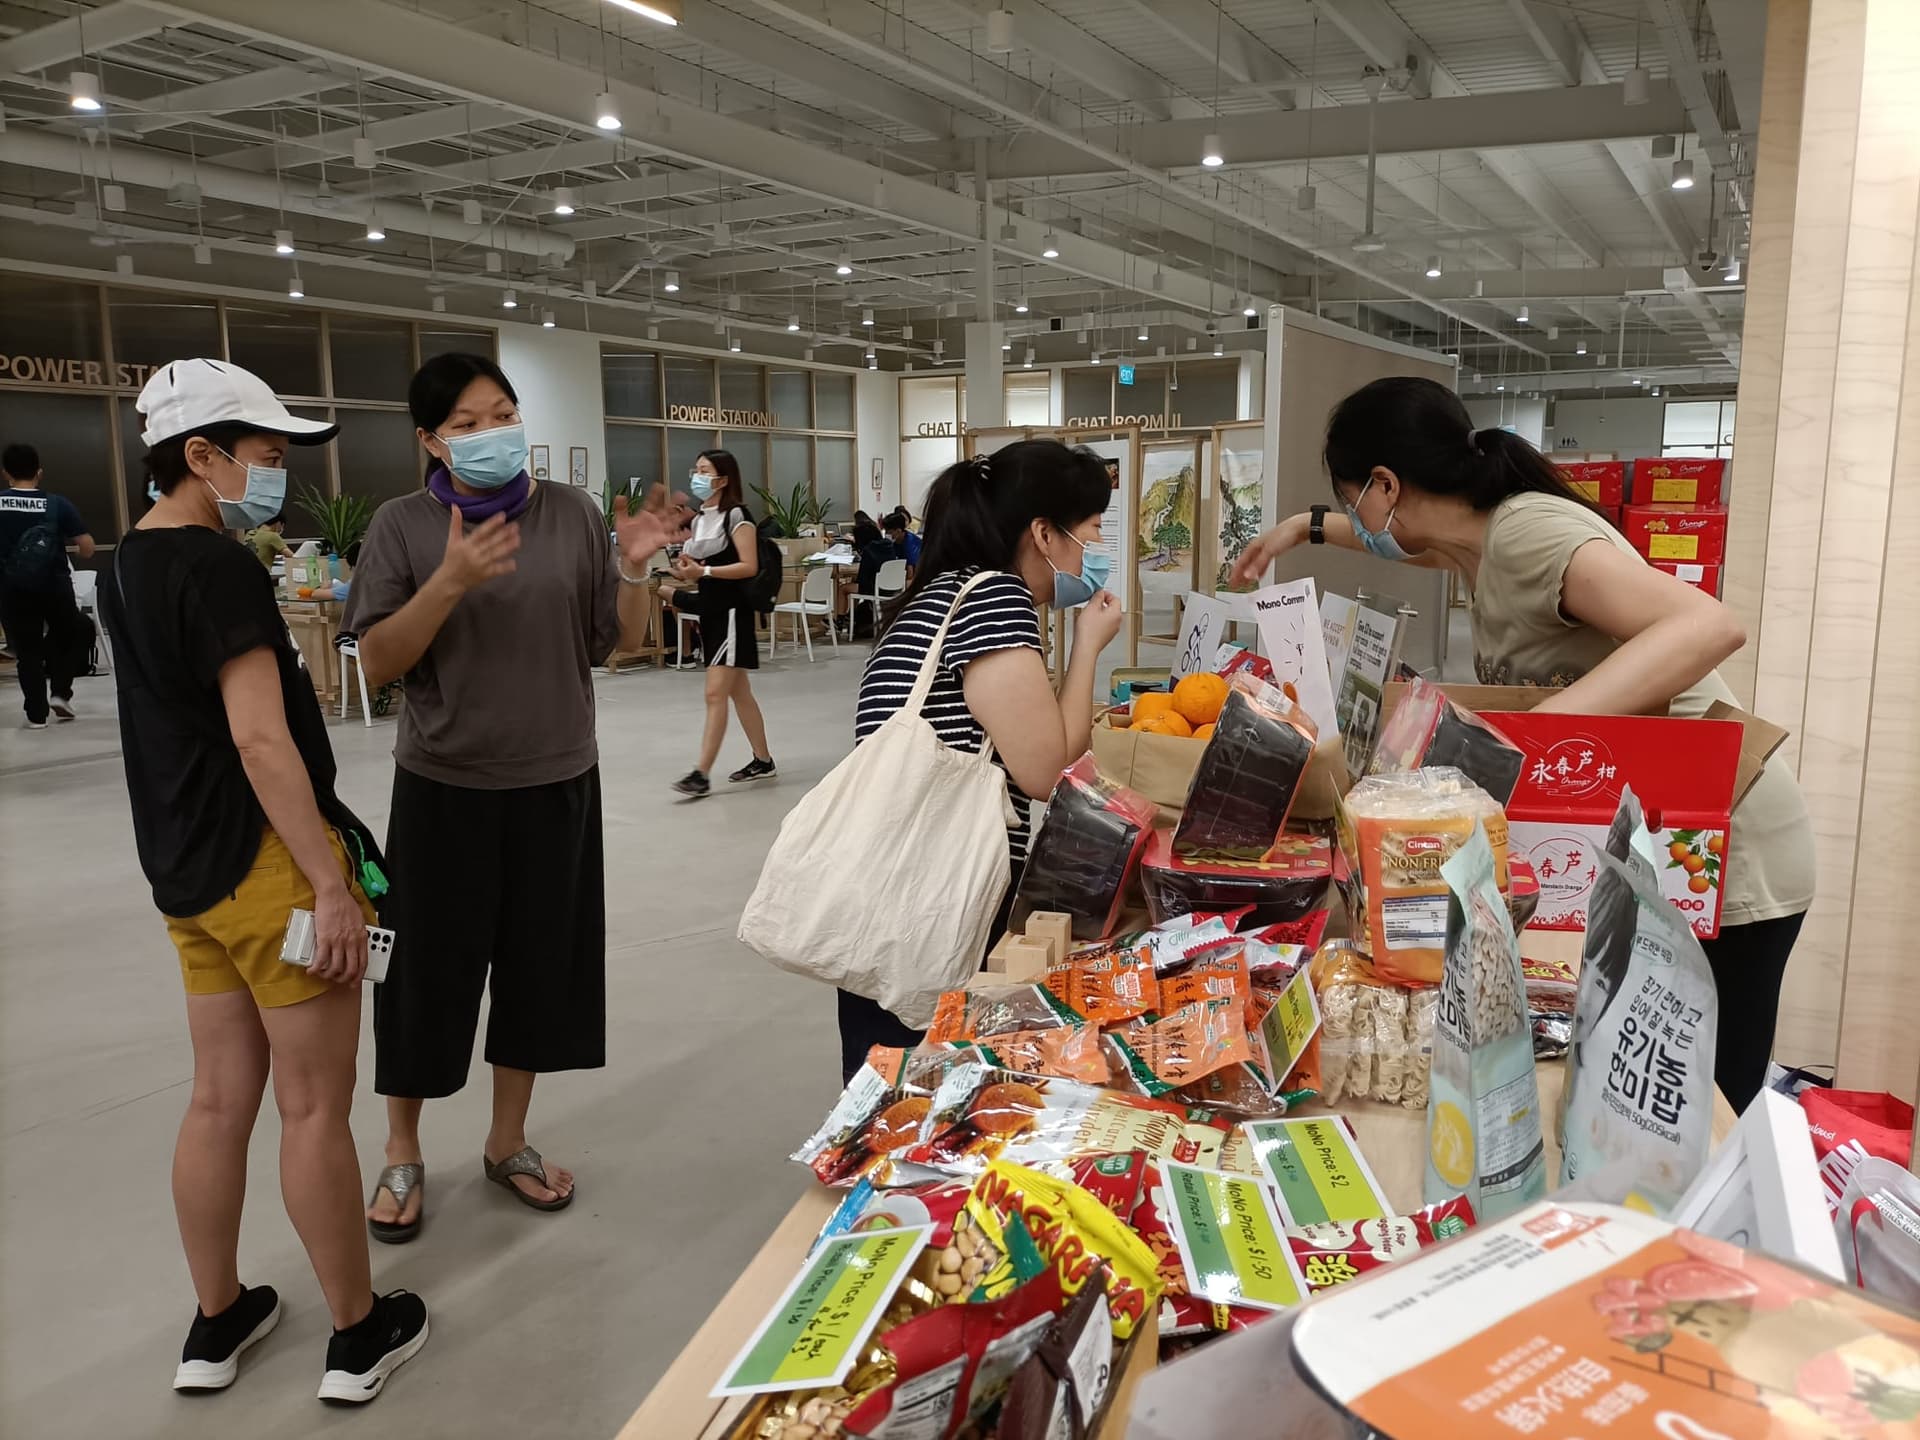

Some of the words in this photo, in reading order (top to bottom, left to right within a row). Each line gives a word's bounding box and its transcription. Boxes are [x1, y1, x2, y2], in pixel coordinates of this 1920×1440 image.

[671, 404, 716, 424] POWER
[721, 408, 768, 427] STATION
[918, 422, 952, 436] CHAT
[1068, 416, 1107, 428] CHAT
[1115, 414, 1163, 429] ROOM
[1256, 600, 1281, 611] Mono
[1529, 749, 1617, 784] 永春芦柑
[1389, 857, 1418, 868] NON
[1537, 850, 1599, 884] 春芦
[1641, 975, 1666, 1001] 잡기
[1660, 991, 1703, 1029] 편하고
[1630, 994, 1652, 1021] 입에
[1648, 1009, 1663, 1030] 잘
[1661, 1020, 1694, 1050] 녹는
[1618, 1016, 1688, 1087] 유기농
[1607, 1051, 1688, 1125] 현미팝
[1132, 1114, 1185, 1151] Happy
[1304, 1123, 1324, 1146] MoNo
[1317, 1146, 1339, 1173] Price:
[1330, 1174, 1350, 1188] $2
[1181, 1171, 1198, 1196] Retail
[1226, 1181, 1250, 1212] MoNo
[1187, 1194, 1202, 1220] Price:
[1237, 1213, 1258, 1245] Price:
[867, 1236, 899, 1269] MoNo
[838, 1270, 876, 1309] Price:
